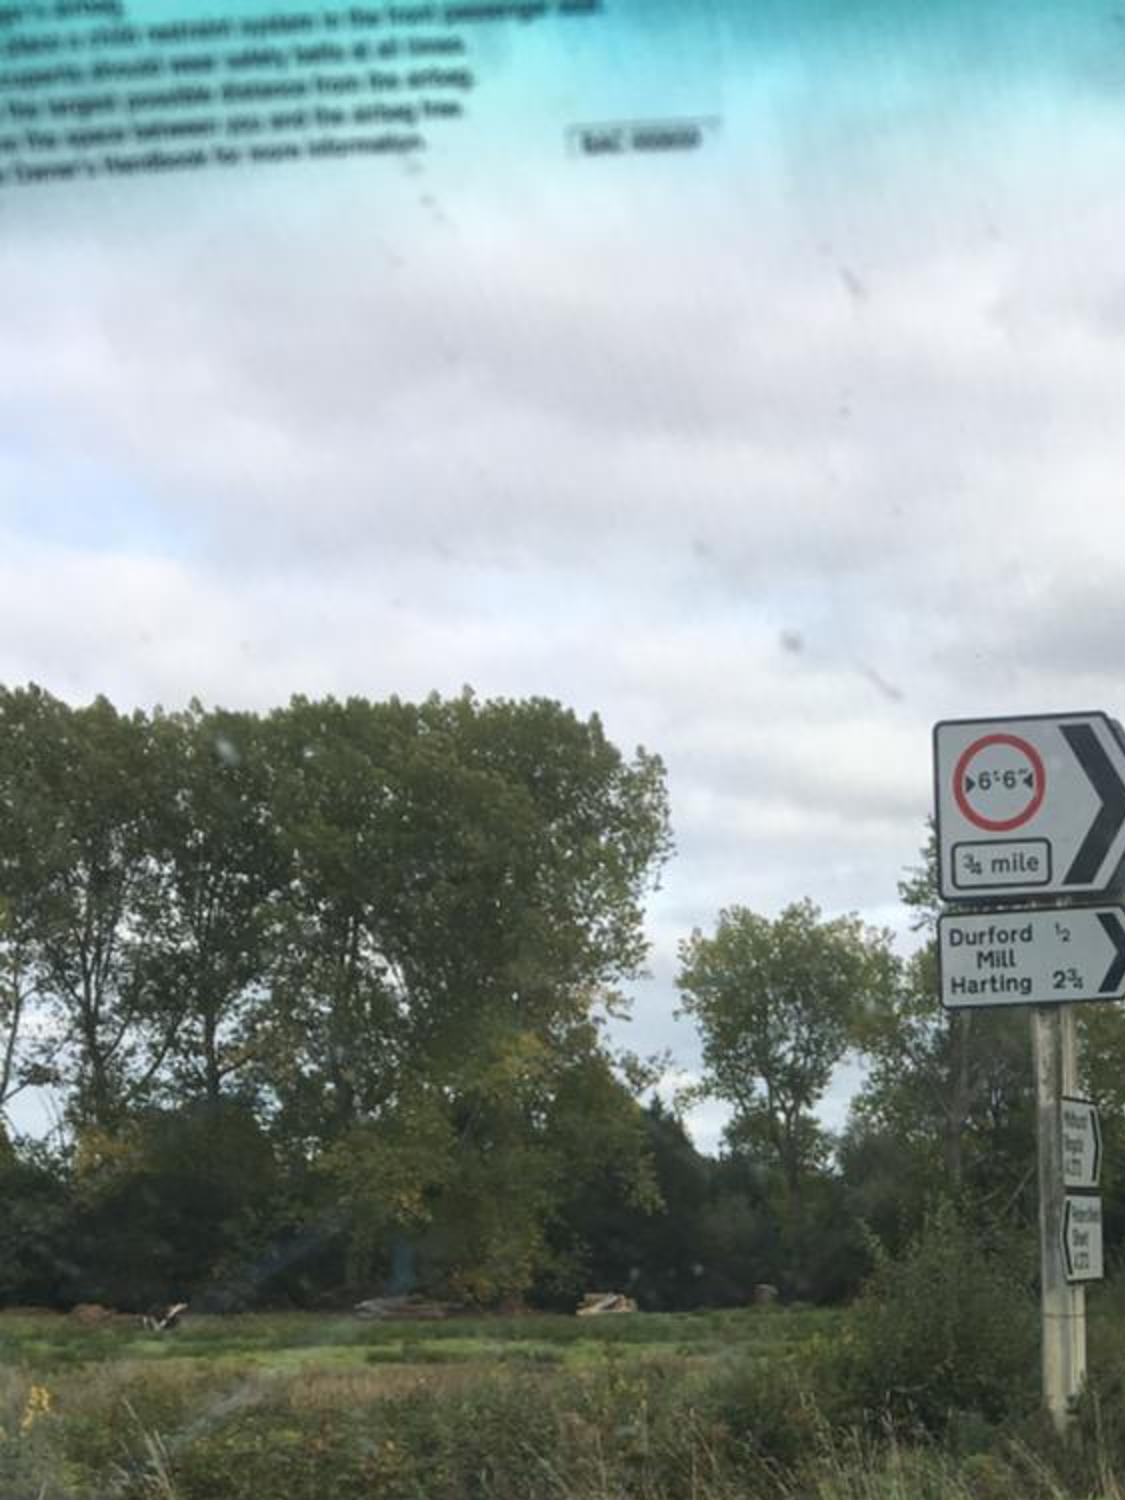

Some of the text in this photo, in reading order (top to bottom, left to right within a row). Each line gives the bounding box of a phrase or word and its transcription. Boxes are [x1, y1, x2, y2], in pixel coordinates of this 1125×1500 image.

[991, 852, 1039, 873] mile
[949, 923, 1033, 946] Durford
[977, 948, 1016, 969] Mill
[951, 973, 1032, 995] Harting
